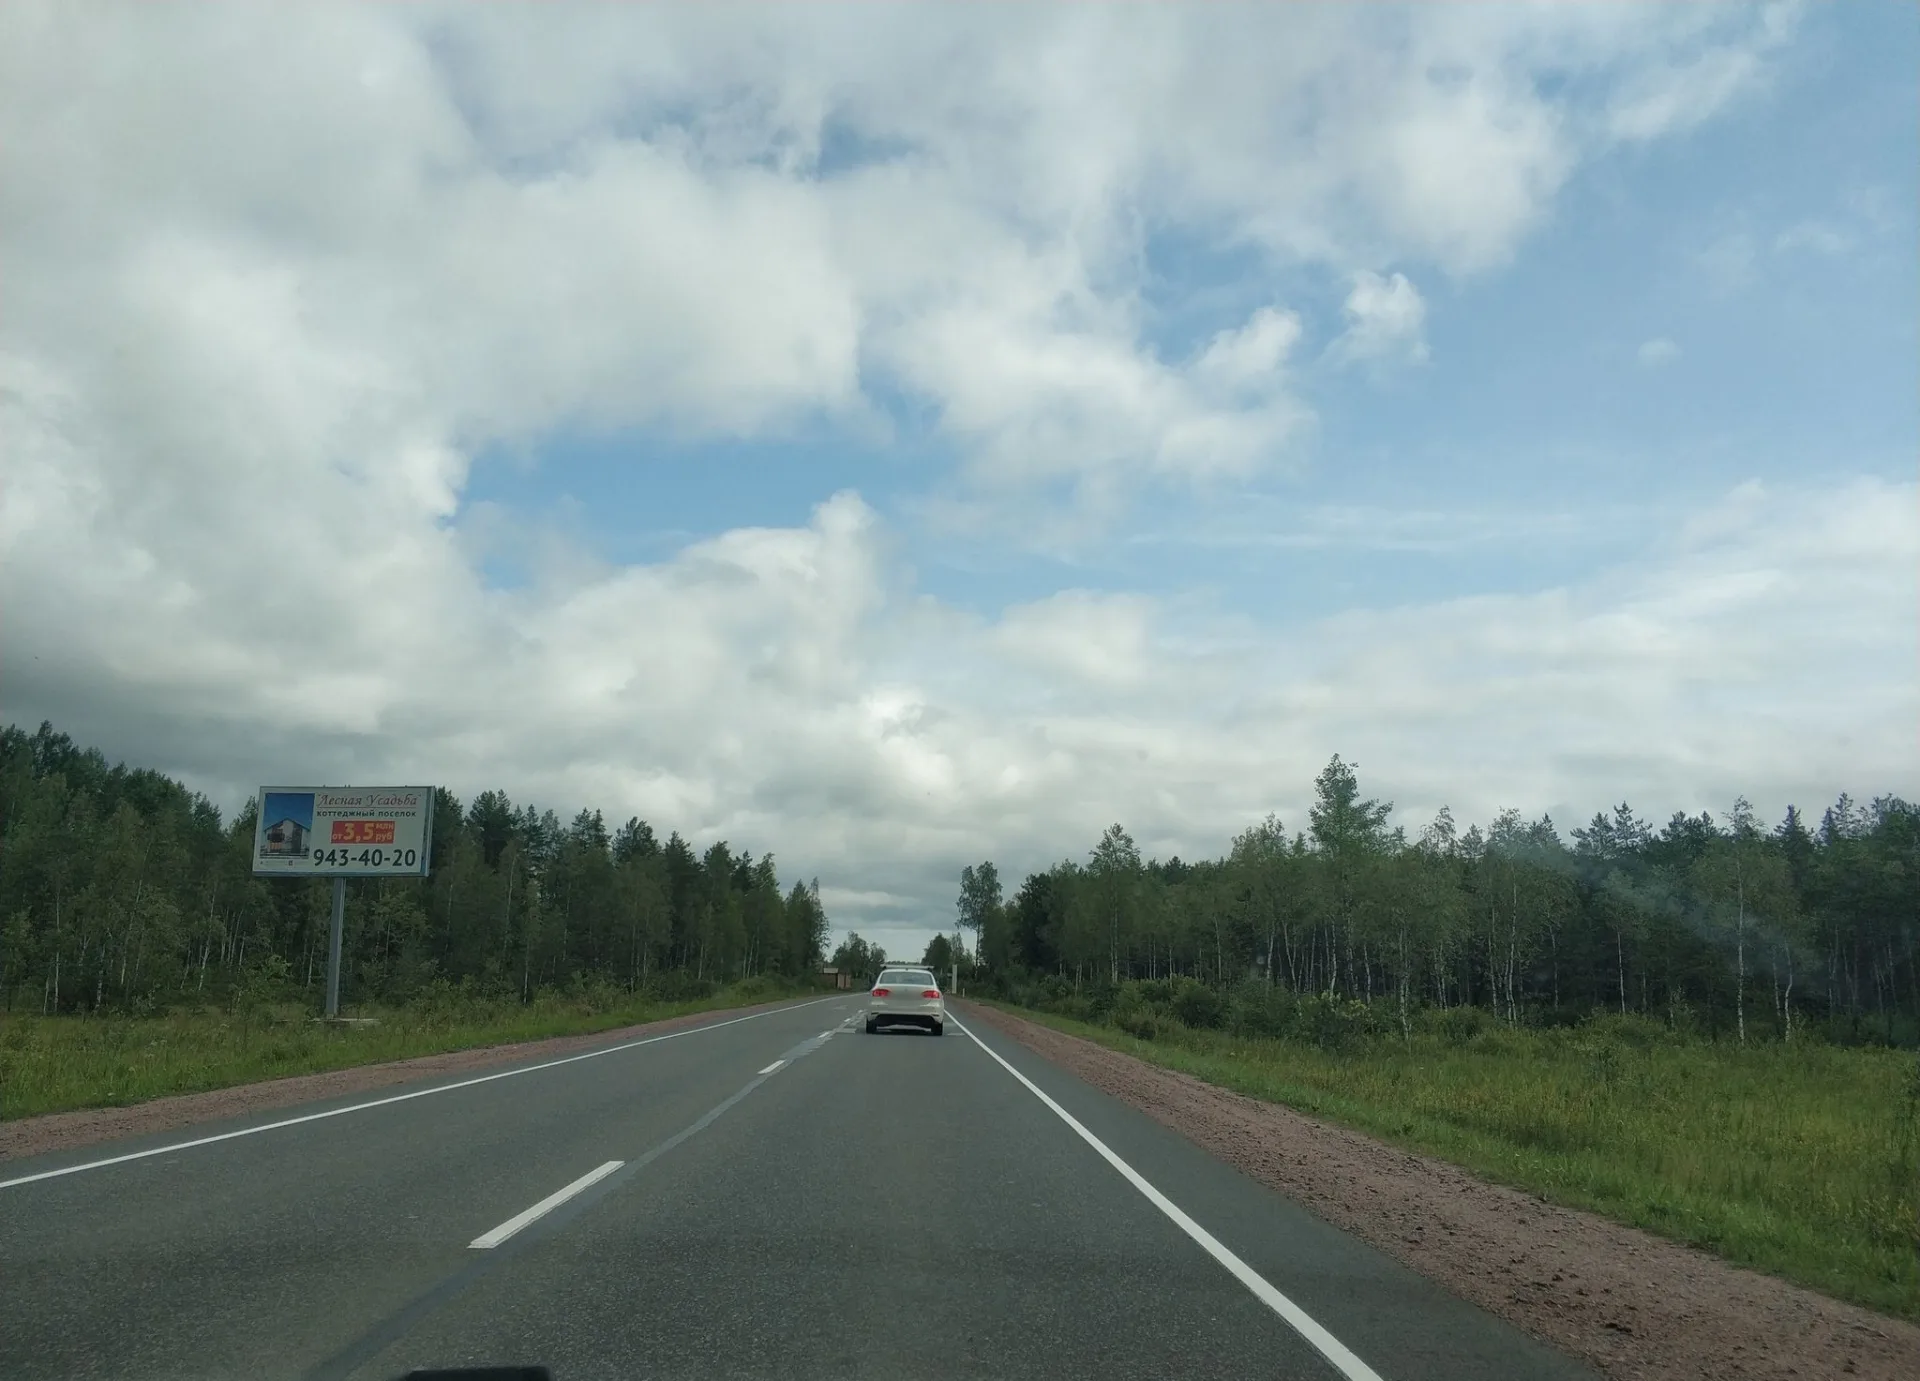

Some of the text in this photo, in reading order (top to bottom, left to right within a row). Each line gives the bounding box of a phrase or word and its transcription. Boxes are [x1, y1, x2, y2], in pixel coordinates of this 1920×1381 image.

[317, 810, 375, 818] коттеджный
[343, 823, 374, 842] 3,5
[376, 832, 393, 841] руб
[313, 848, 416, 867] 943-40-20
